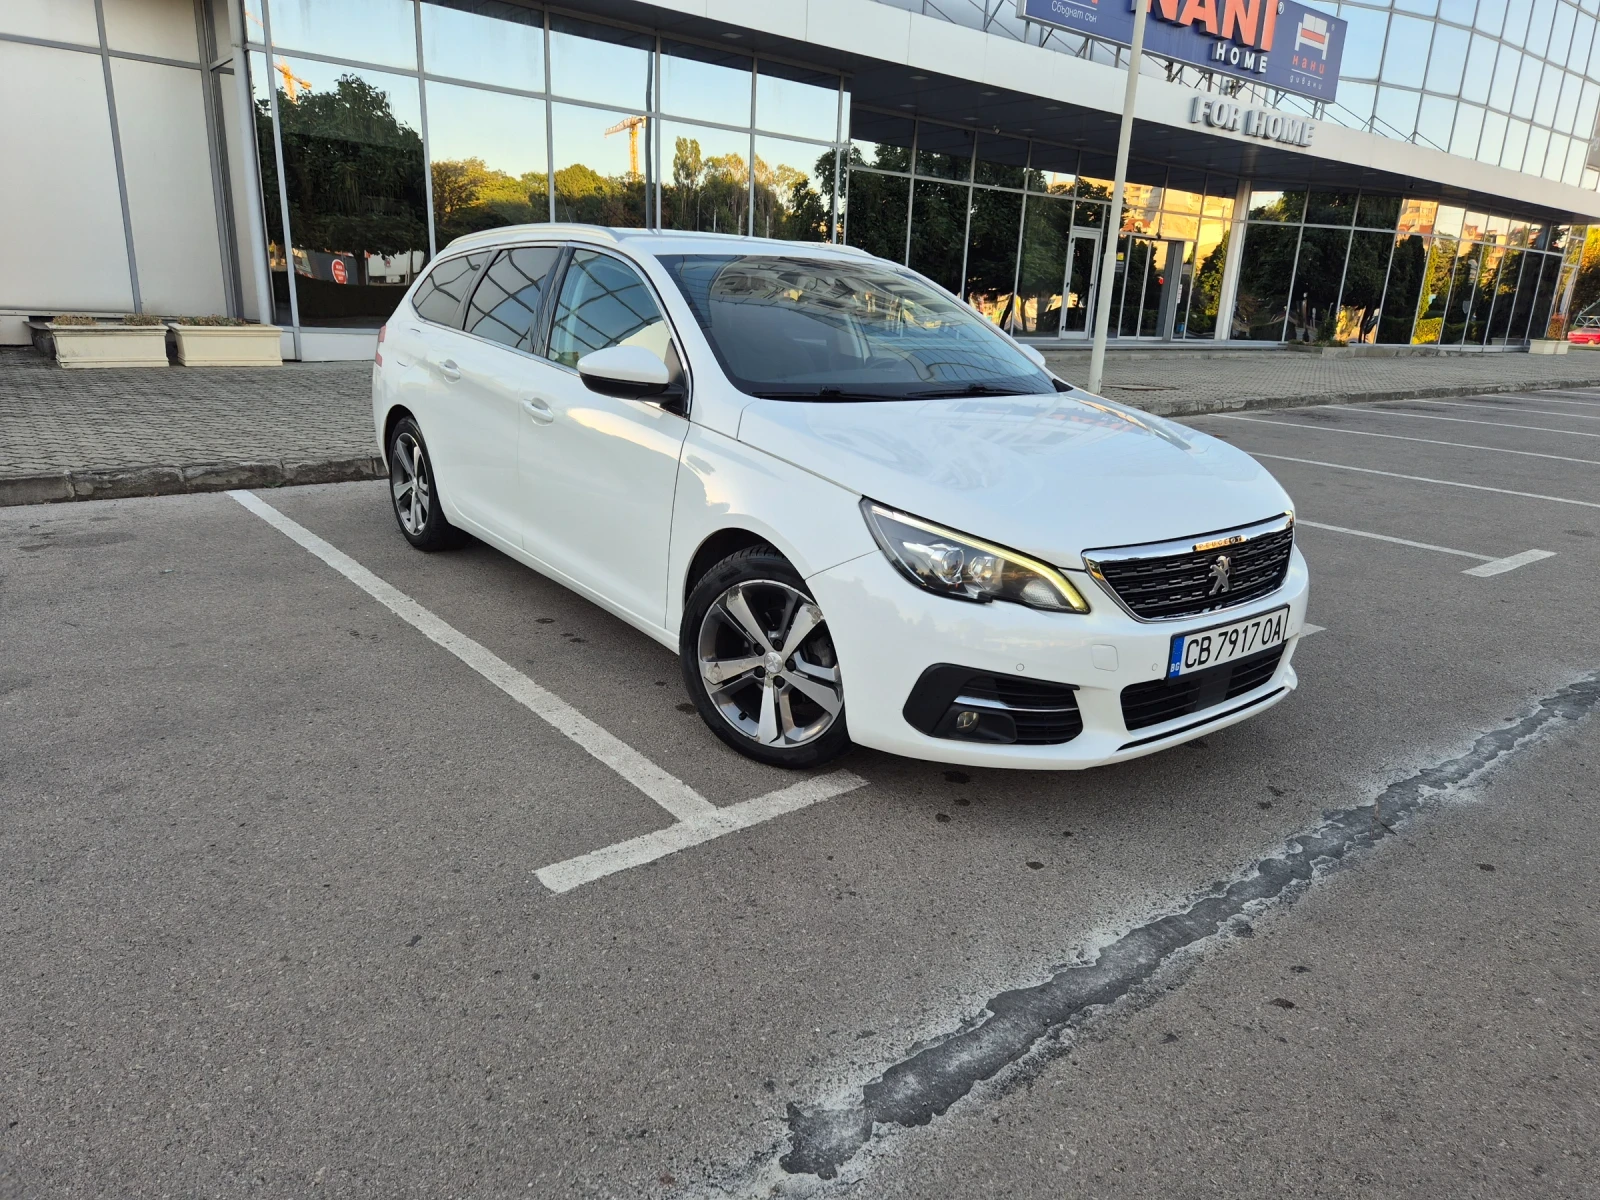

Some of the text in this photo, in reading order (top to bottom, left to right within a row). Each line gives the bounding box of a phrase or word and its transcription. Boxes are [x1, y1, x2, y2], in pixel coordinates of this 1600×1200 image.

[1144, 0, 1278, 52] ANI
[1215, 42, 1268, 73] HOME
[1194, 96, 1315, 147] FOR HOME
[1198, 536, 1242, 548] PEUGEOT
[1185, 635, 1212, 669] CB
[1214, 621, 1261, 661] 7917
[1170, 662, 1180, 673] BG
